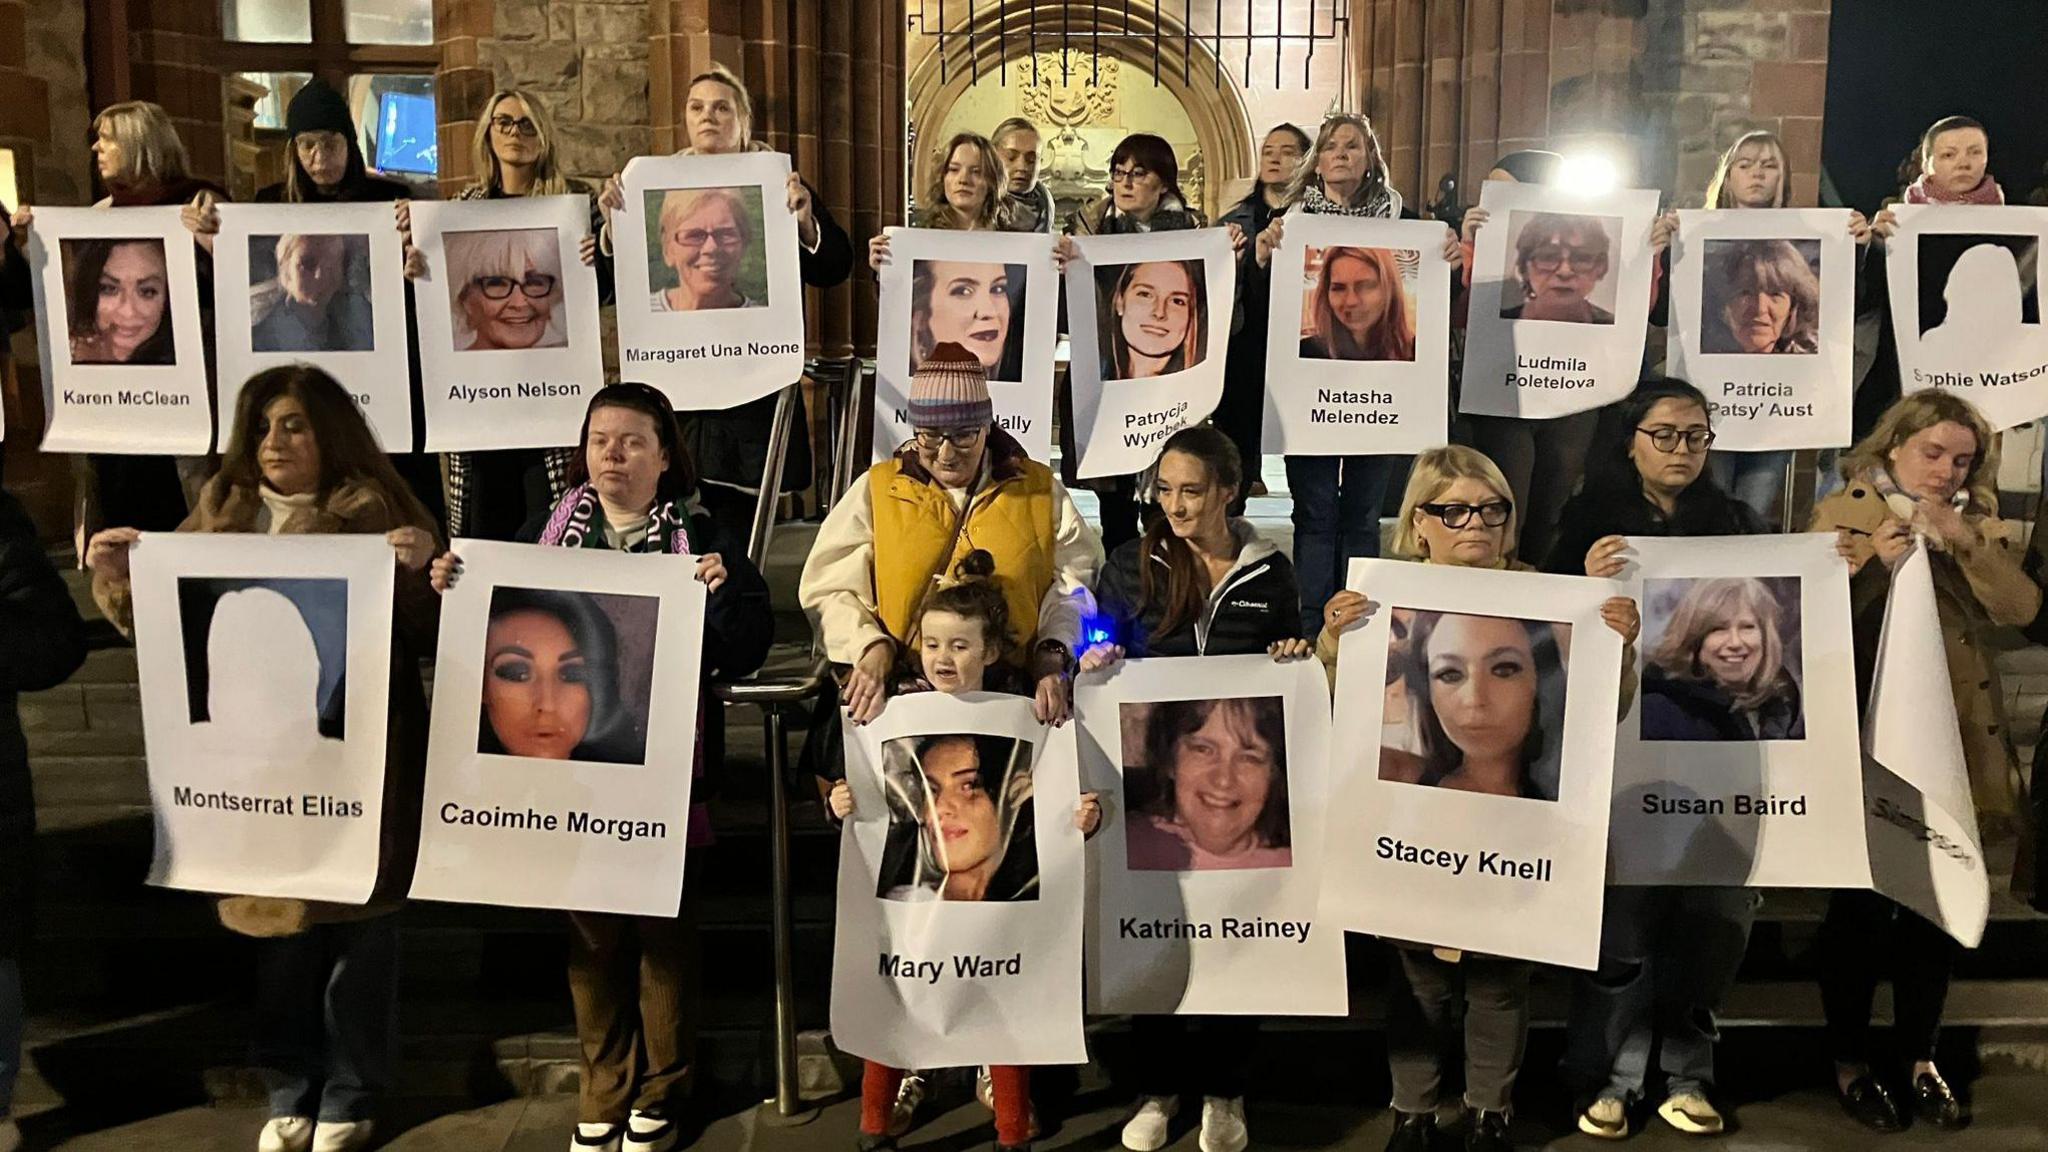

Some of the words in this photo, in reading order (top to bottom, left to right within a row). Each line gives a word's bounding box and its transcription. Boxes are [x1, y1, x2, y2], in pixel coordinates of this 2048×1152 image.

[626, 345, 707, 364] Maragaret
[711, 343, 743, 358] Una
[747, 341, 800, 356] Noone
[1517, 354, 1587, 372] Ludmila
[448, 384, 512, 404] Alyson
[517, 381, 581, 398] Nelson
[1505, 373, 1595, 390] Poletelova
[1723, 381, 1793, 397] Patricia
[63, 389, 113, 405] Karen
[117, 390, 190, 406] McClean
[1318, 388, 1393, 405] Natasha
[1124, 401, 1189, 429] Patrycja
[1311, 408, 1399, 425] Melendez
[1768, 402, 1814, 417] Aust
[1122, 415, 1189, 449] Wyrebek
[173, 786, 294, 816] Montserrat
[302, 794, 363, 818] Elias
[1642, 793, 1724, 816] Susan
[1734, 794, 1807, 816] Baird
[440, 802, 558, 831] Caoimhe
[566, 811, 667, 842] Morgan
[1376, 836, 1470, 876] Stacey
[1478, 850, 1552, 882] Knell
[1119, 917, 1213, 939] Katrina
[1221, 916, 1312, 944] Rainey
[878, 952, 945, 985] Mary
[952, 952, 1021, 979] Ward
